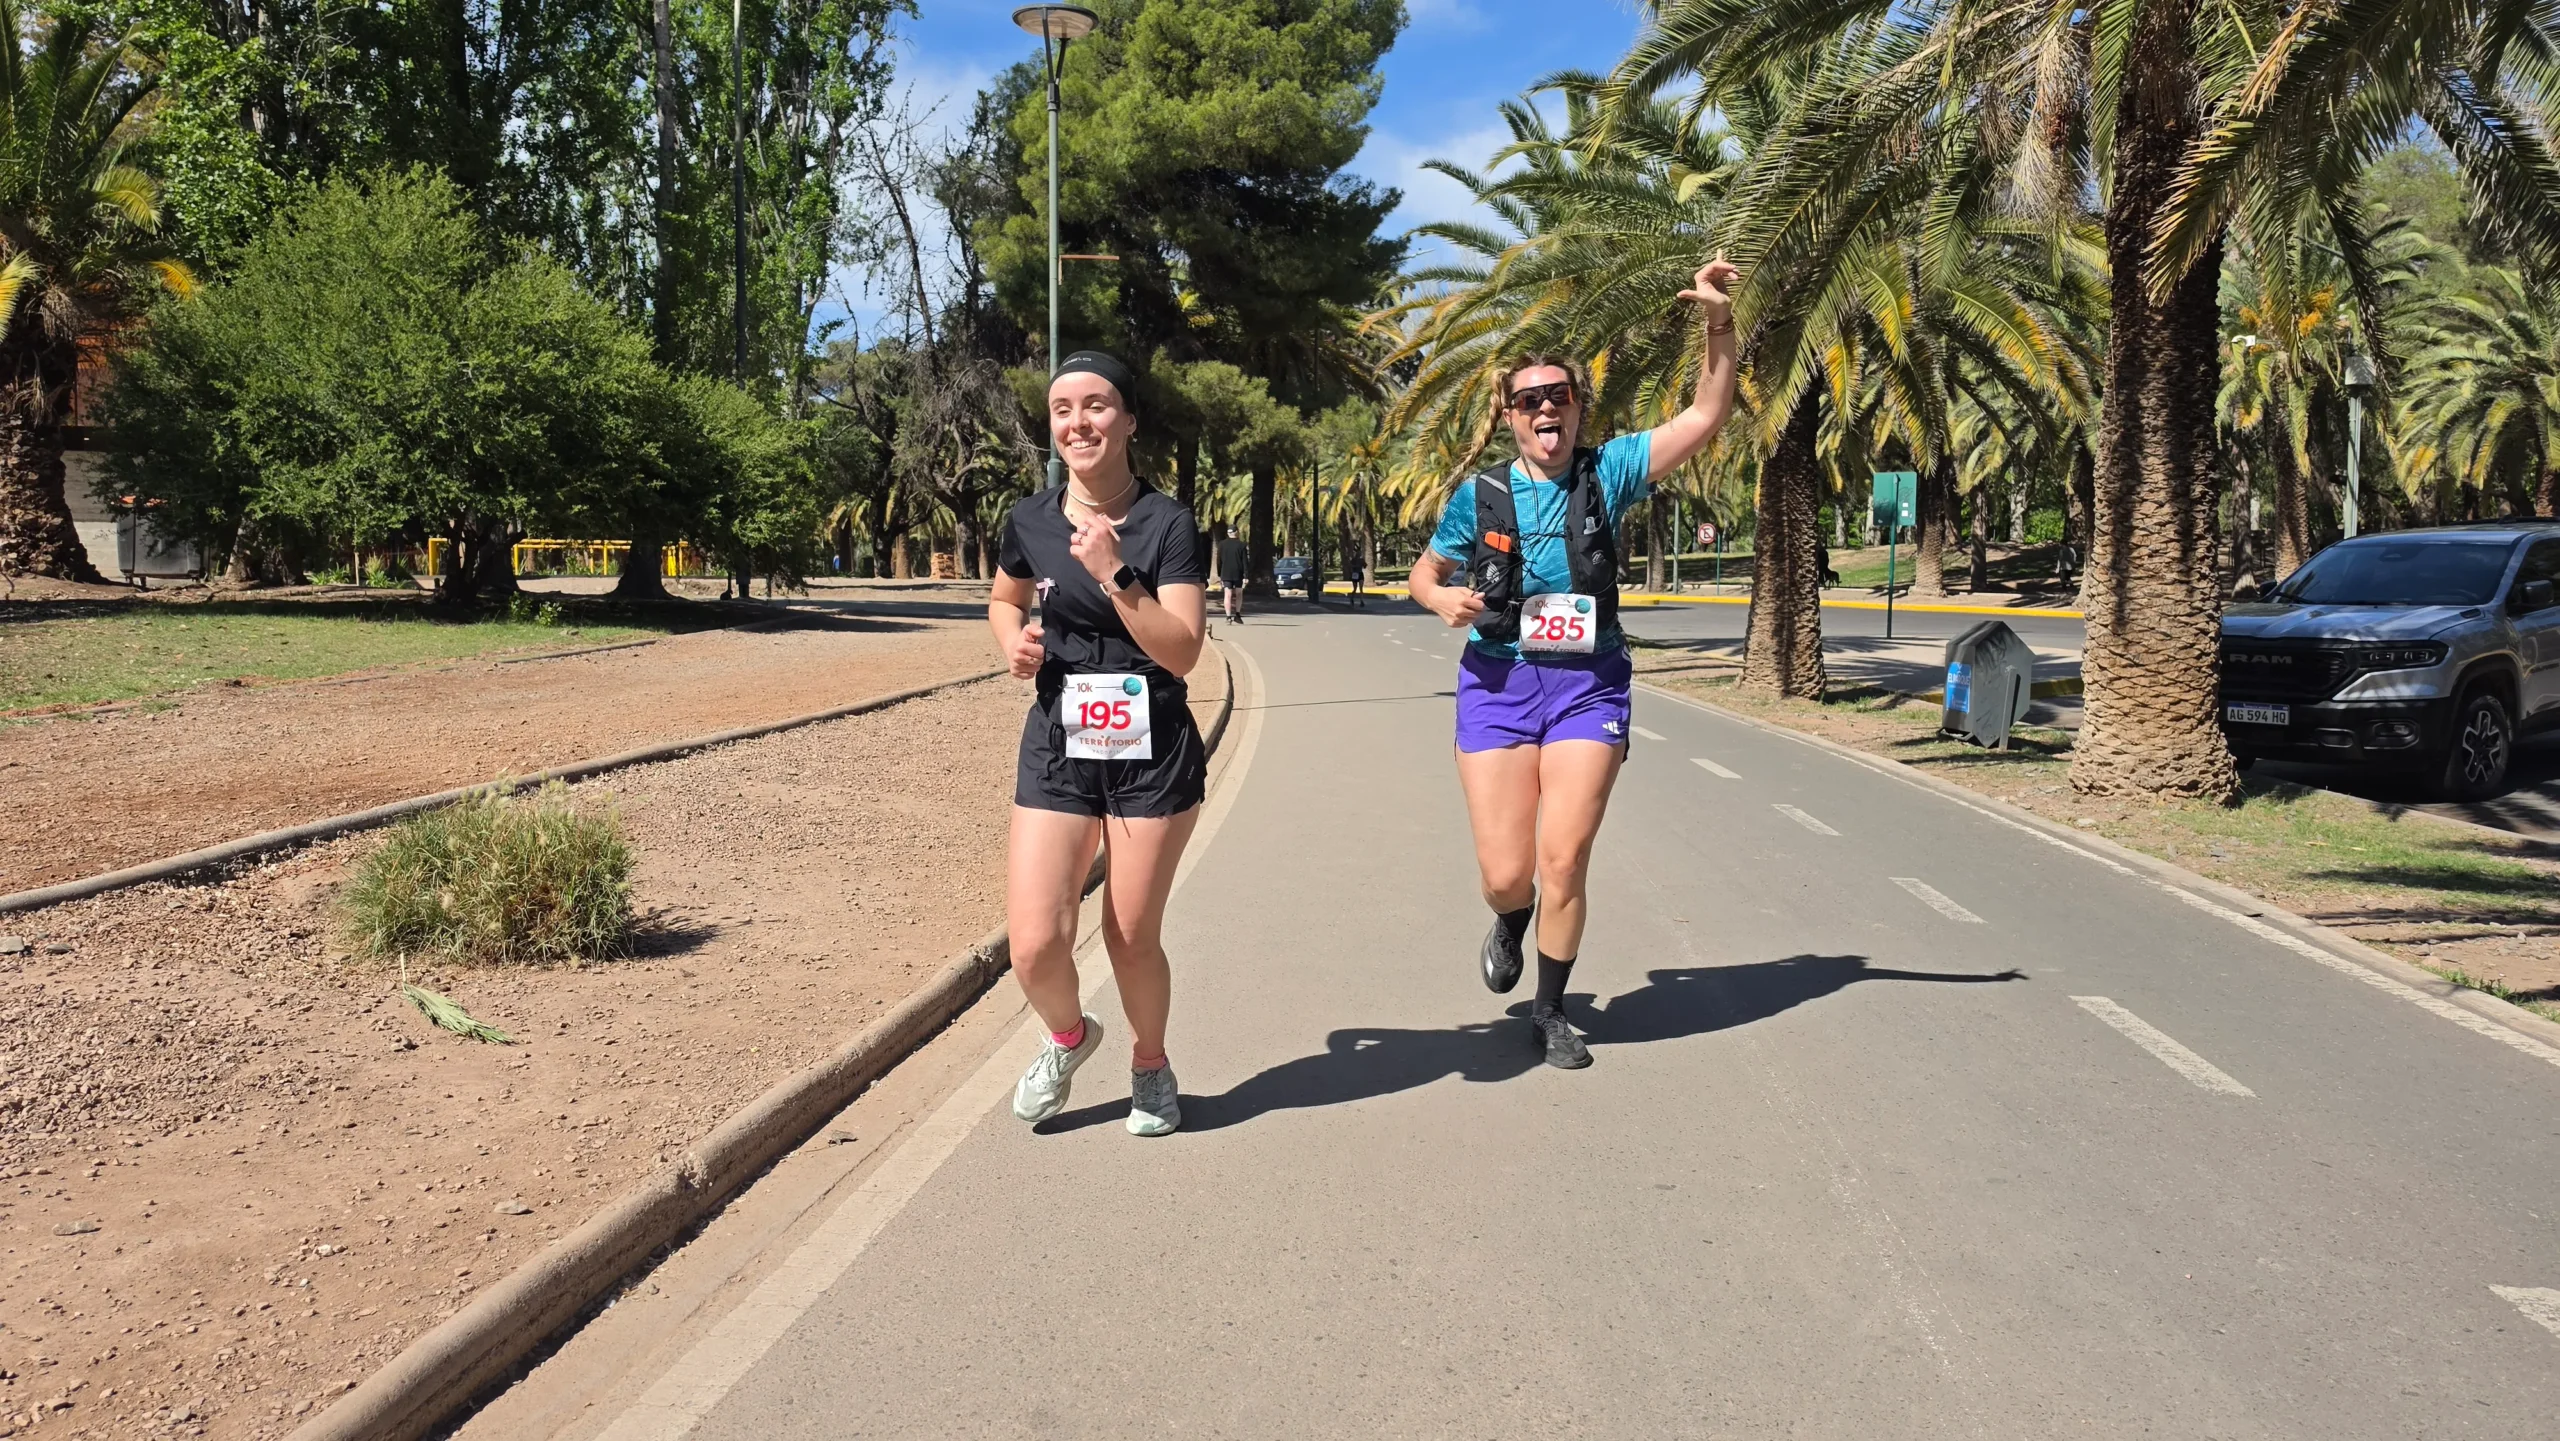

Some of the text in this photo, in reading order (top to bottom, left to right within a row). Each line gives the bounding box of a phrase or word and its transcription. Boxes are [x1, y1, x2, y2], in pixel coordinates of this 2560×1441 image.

[1534, 600, 1549, 609] 10k
[1526, 614, 1586, 642] 285
[2229, 653, 2293, 664] RAM
[1076, 682, 1093, 693] 10k
[1078, 700, 1132, 730] 195
[2229, 708, 2286, 723] AG 594 HQ
[1079, 735, 1142, 747] TERRITORIO
